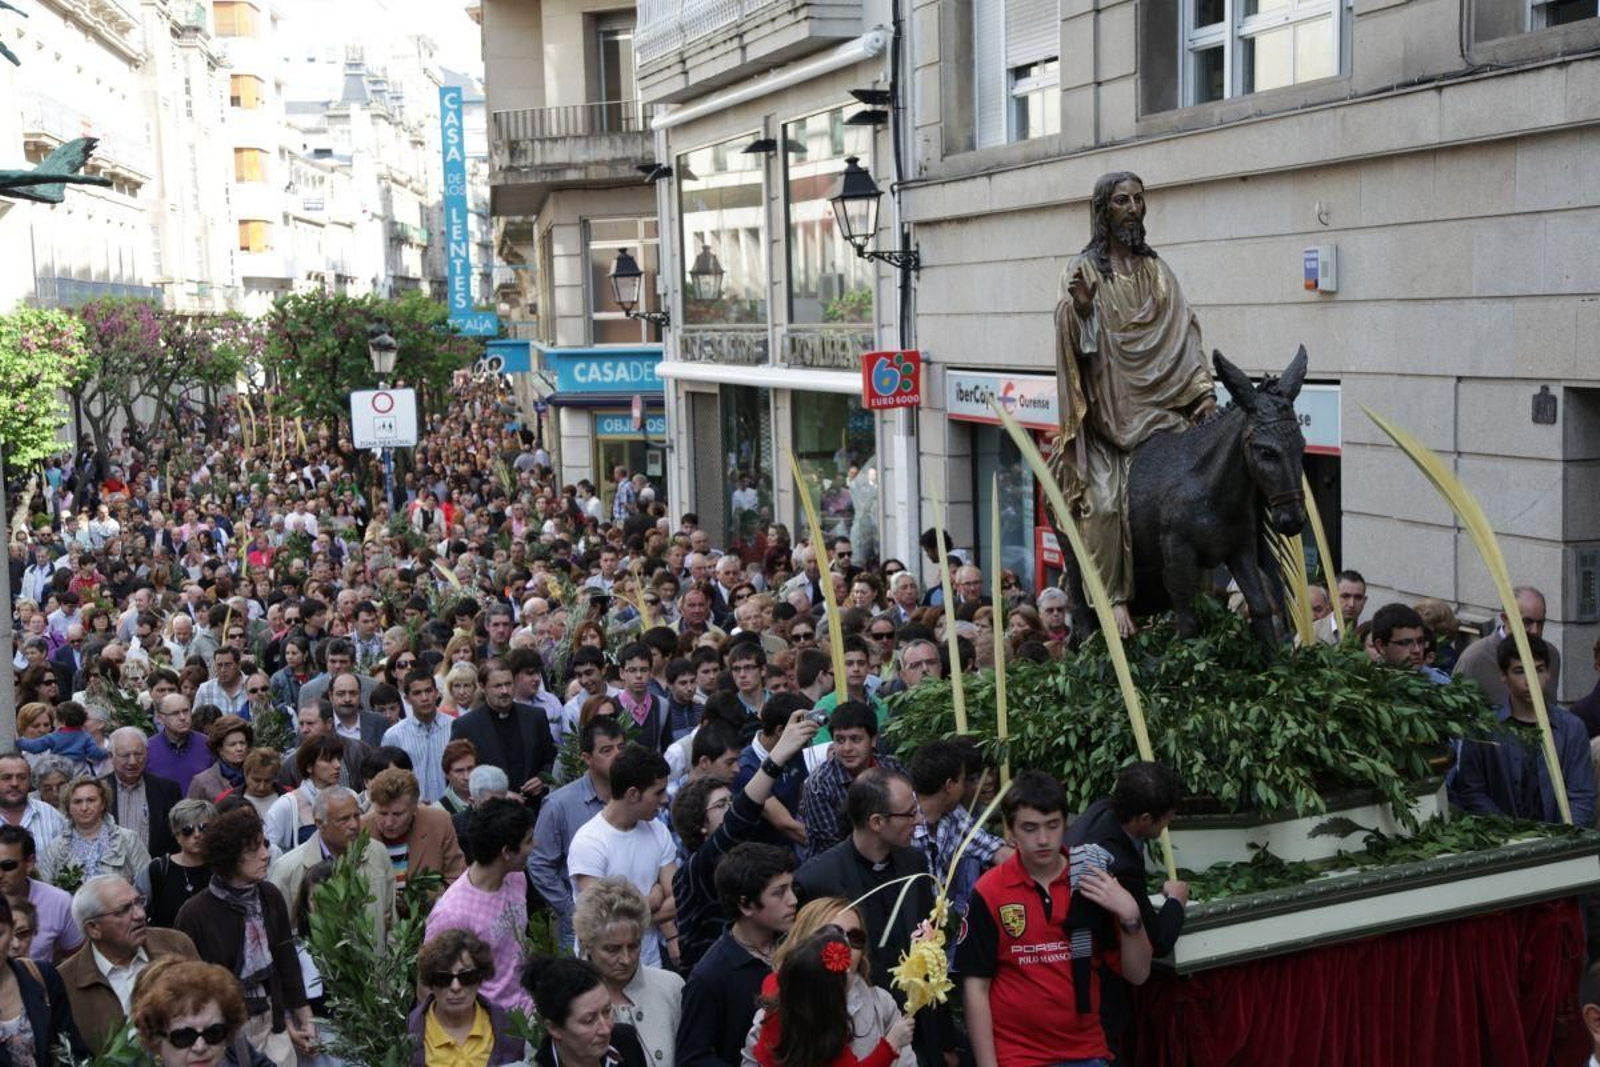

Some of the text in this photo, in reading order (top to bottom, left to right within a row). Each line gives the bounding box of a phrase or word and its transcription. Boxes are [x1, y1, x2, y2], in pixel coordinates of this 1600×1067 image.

[444, 92, 461, 162] CASA
[447, 172, 463, 185] DE
[445, 184, 466, 196] LOS
[451, 208, 467, 309] LENTES
[871, 394, 920, 407] EURO 6000
[1019, 394, 1050, 410] Ourense
[603, 418, 665, 432] OBJOS
[1011, 941, 1070, 954] PORSC
[1018, 952, 1071, 966] POLO MANNSC
